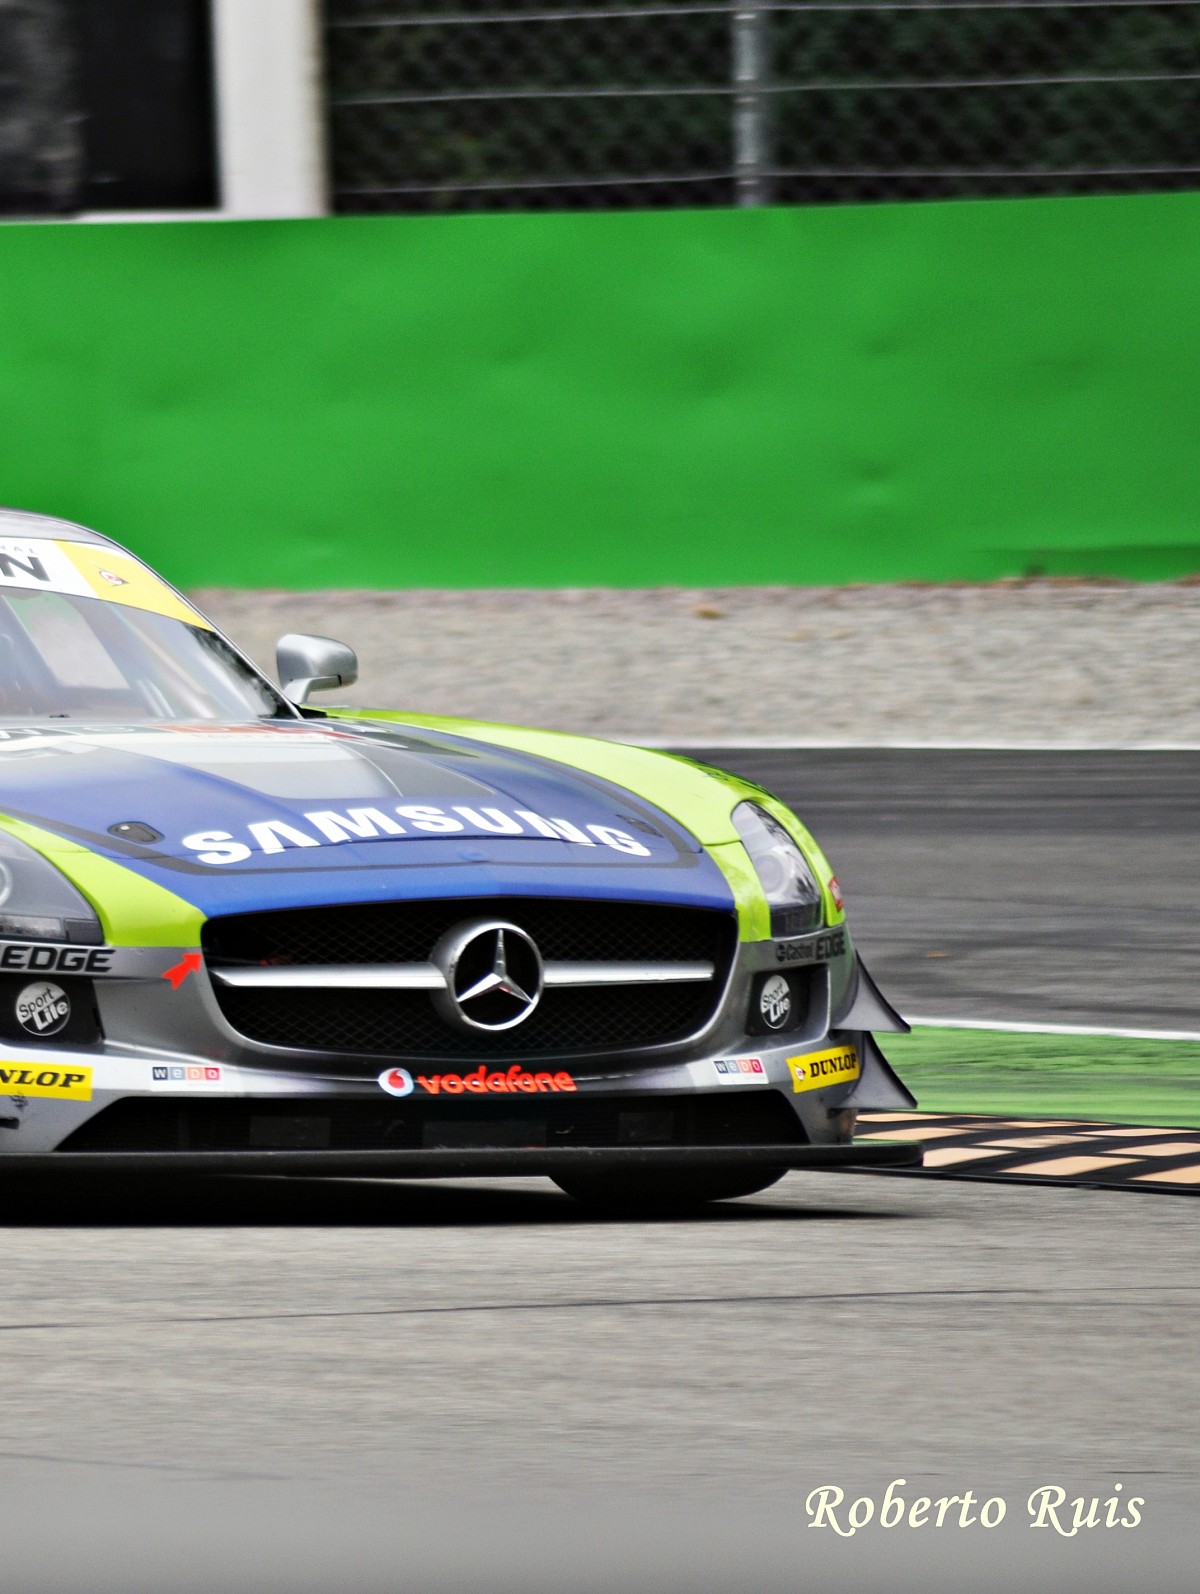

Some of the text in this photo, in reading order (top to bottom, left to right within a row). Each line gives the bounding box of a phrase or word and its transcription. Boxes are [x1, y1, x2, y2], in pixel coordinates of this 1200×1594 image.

[182, 804, 652, 866] SAMSUNG
[0, 945, 117, 973] EDGE
[815, 931, 846, 961] EDGE
[19, 987, 54, 1019] Sport
[417, 1064, 577, 1095] vodafone
[810, 1053, 857, 1078] DUNLOP
